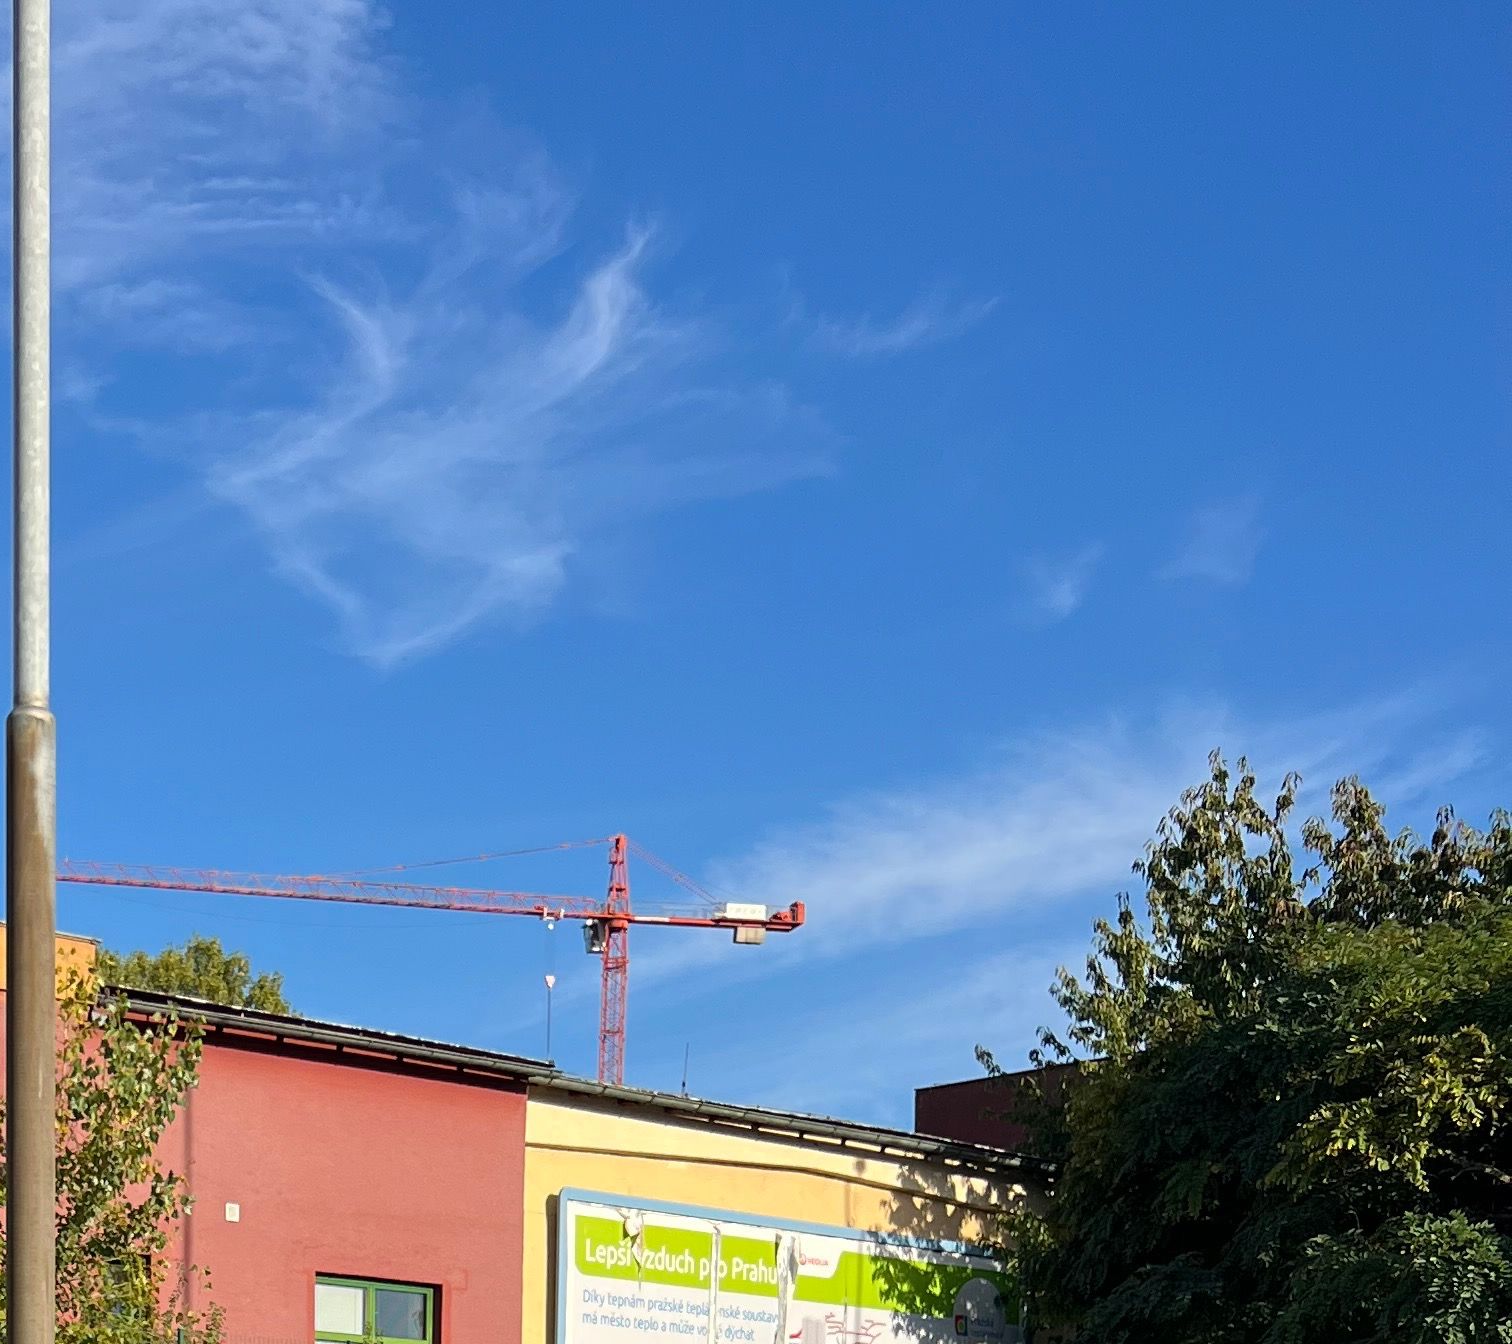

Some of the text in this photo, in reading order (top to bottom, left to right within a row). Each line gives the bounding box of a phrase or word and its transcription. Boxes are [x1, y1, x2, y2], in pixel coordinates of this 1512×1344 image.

[585, 1236, 633, 1270] Lepší
[699, 1257, 728, 1281] po
[732, 1257, 778, 1284] Prahu
[583, 1289, 605, 1307] Díky
[608, 1292, 645, 1309] tepnám
[600, 1312, 630, 1328] město
[634, 1316, 658, 1332] teplo
[661, 1321, 666, 1332] a
[725, 1325, 754, 1342] dýchat
